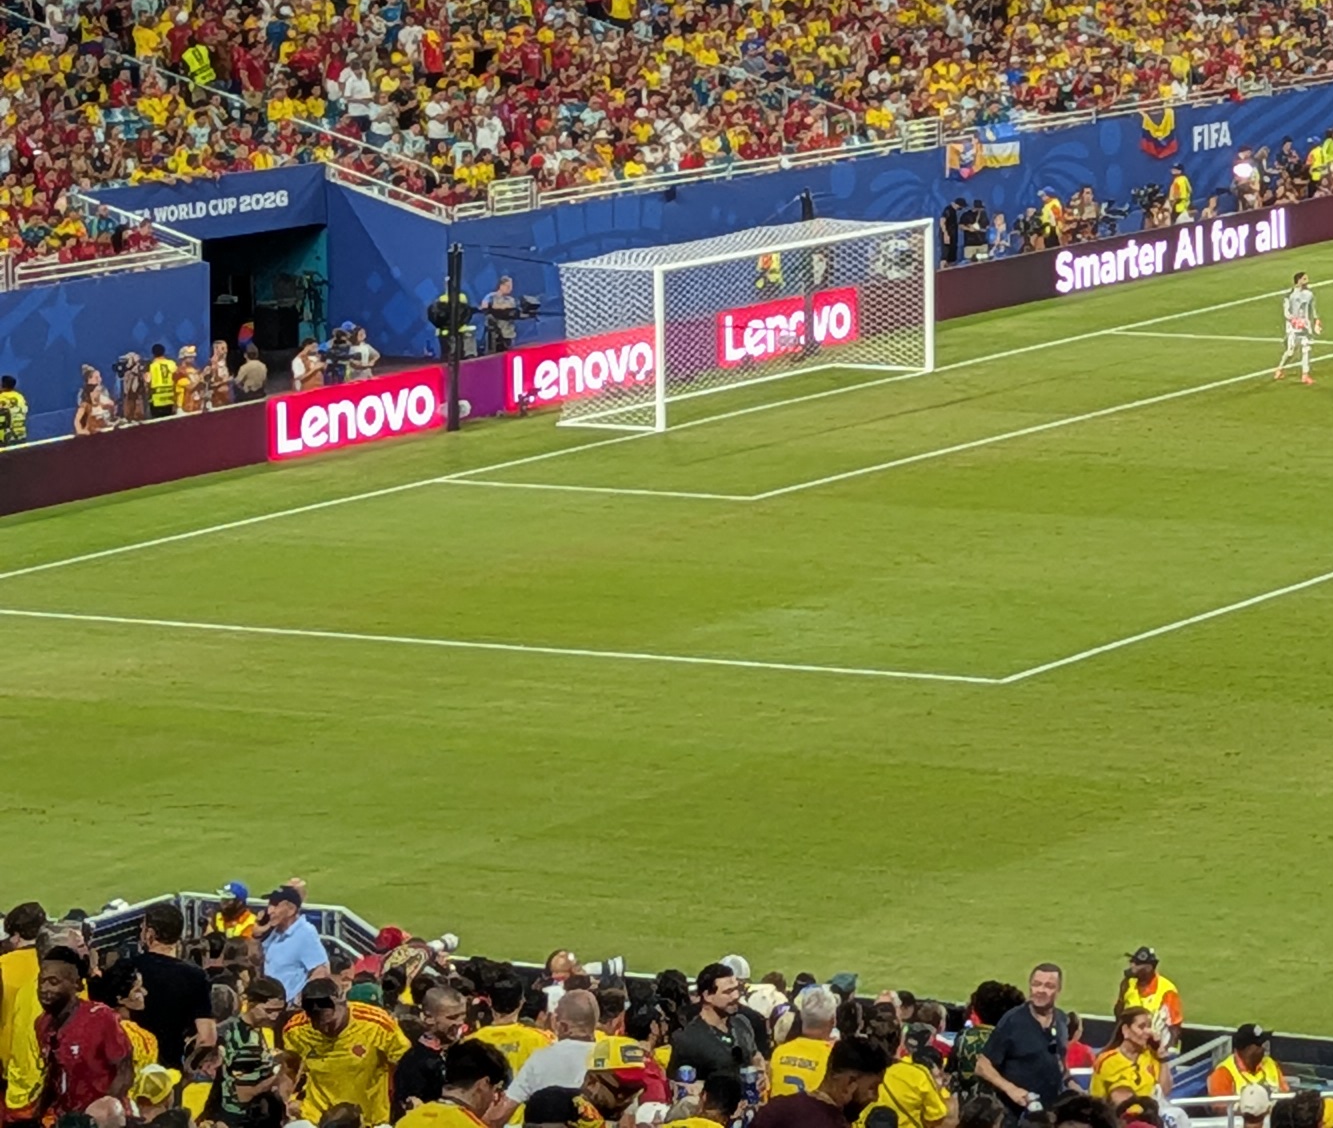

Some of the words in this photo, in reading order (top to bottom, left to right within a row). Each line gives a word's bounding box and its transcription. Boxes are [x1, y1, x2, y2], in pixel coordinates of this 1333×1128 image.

[1193, 121, 1232, 152] FIFA
[154, 201, 207, 223] WORLD
[208, 196, 237, 217] CUP
[239, 190, 289, 213] 2026
[1055, 240, 1167, 293] Smarter
[1173, 225, 1203, 270] AI
[1211, 219, 1249, 262] for
[1255, 208, 1286, 253] all
[725, 302, 850, 362] Lenovo
[512, 340, 653, 403] Lenovo
[276, 384, 435, 454] Lenovo
